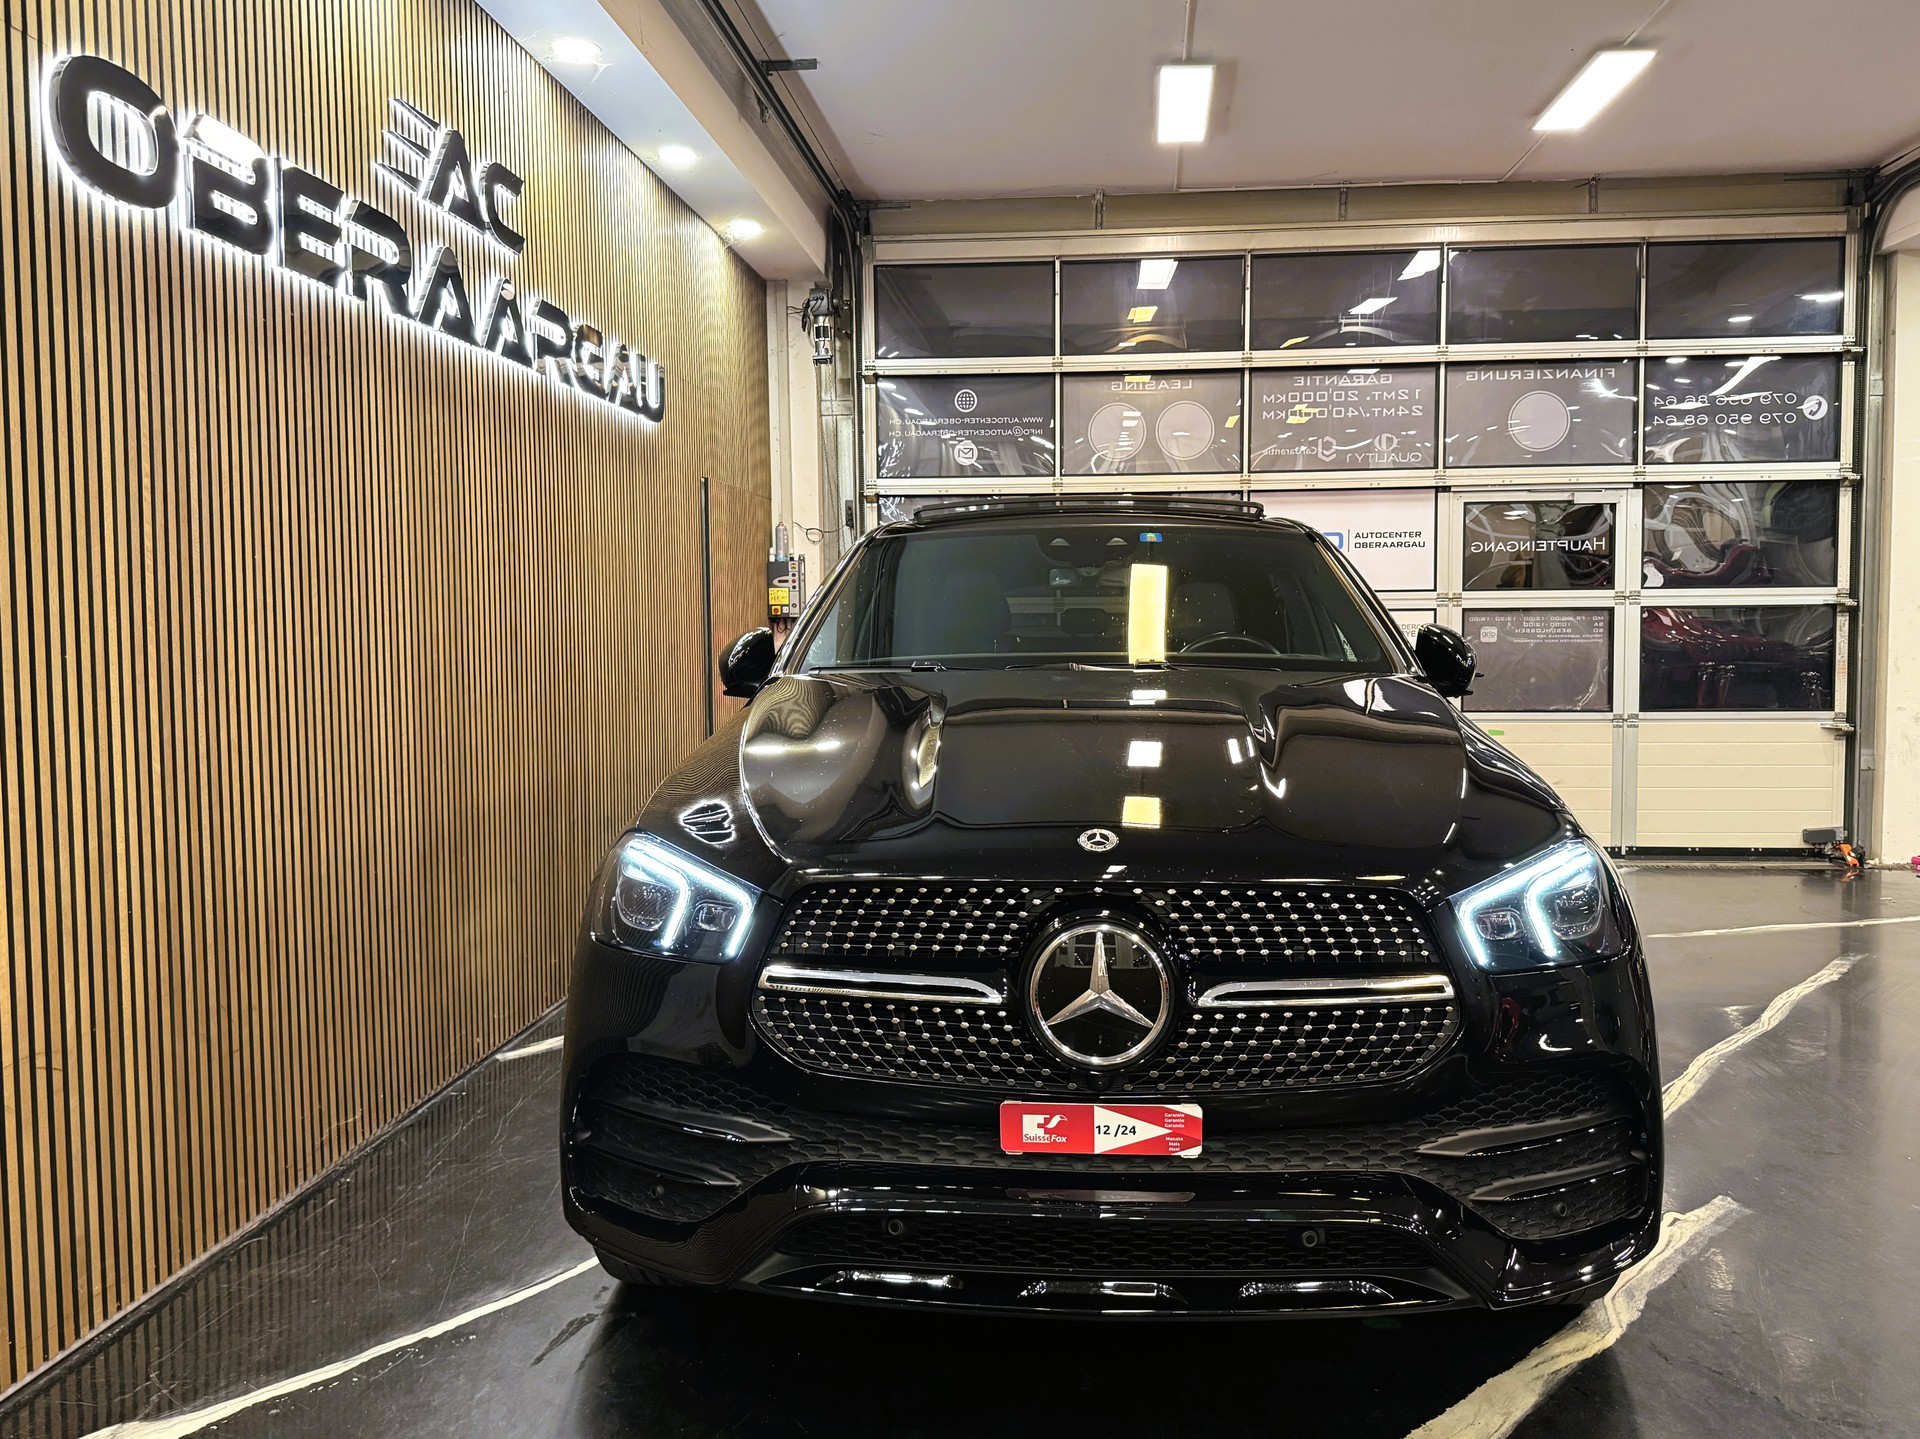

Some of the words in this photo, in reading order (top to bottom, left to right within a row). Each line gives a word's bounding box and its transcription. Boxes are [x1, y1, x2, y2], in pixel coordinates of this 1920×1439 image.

[48, 54, 666, 423] OBERAARGAU
[1354, 531, 1422, 539] AUTOCENTER
[1354, 541, 1425, 549] OBERAARGAU
[1095, 1125, 1111, 1135] 12
